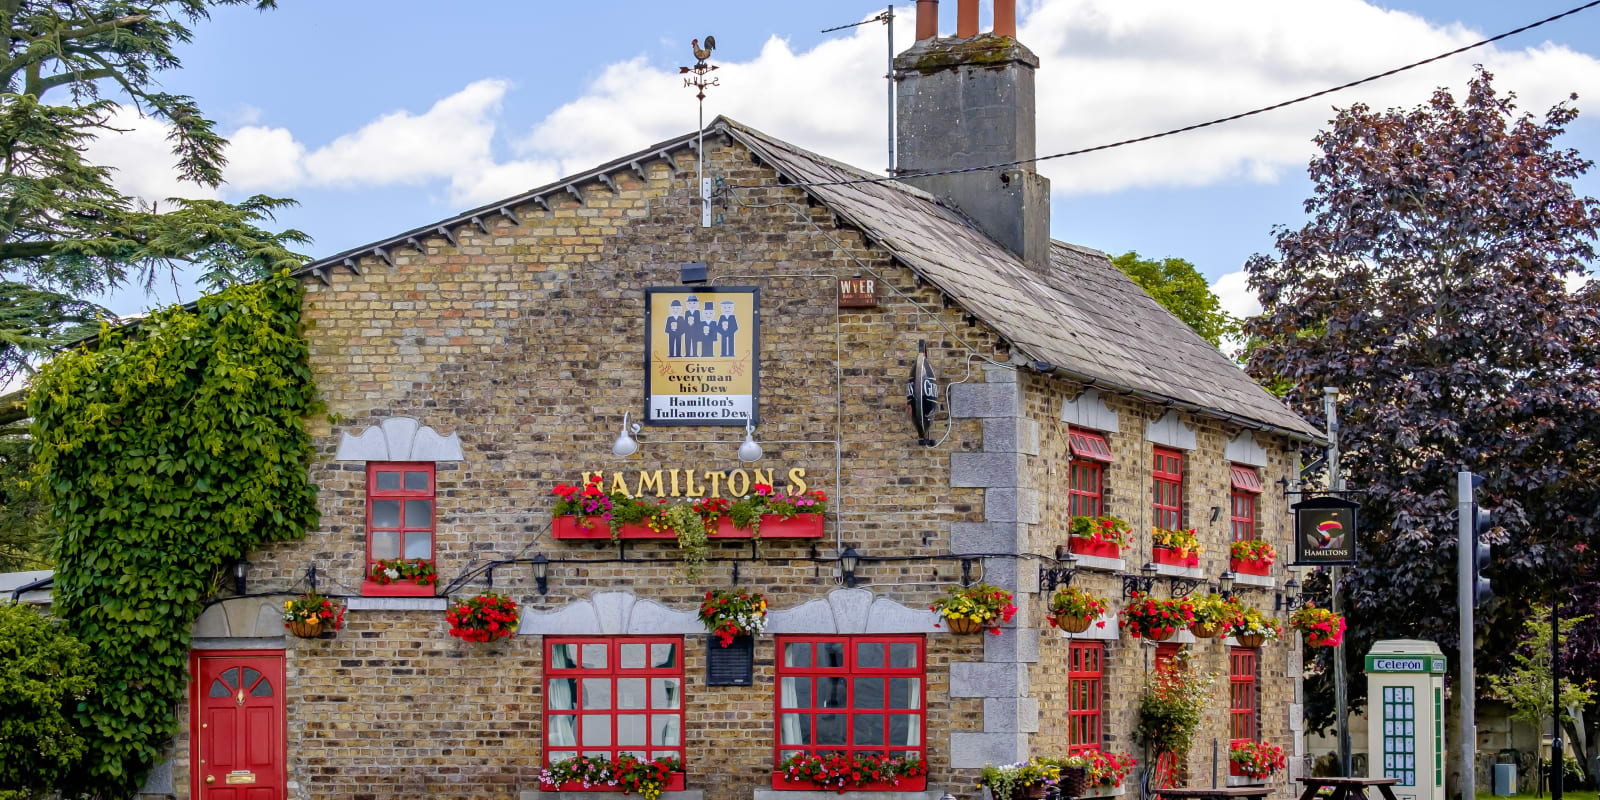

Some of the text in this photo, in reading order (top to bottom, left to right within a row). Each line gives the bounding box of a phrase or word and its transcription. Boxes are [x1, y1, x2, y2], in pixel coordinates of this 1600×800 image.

[685, 363, 715, 373] Give
[668, 375, 702, 384] every
[680, 383, 727, 393] his Dew
[669, 397, 734, 407] Hamilton's
[655, 408, 748, 418] Tullamore Dew
[1304, 549, 1348, 557] HAMILTONS
